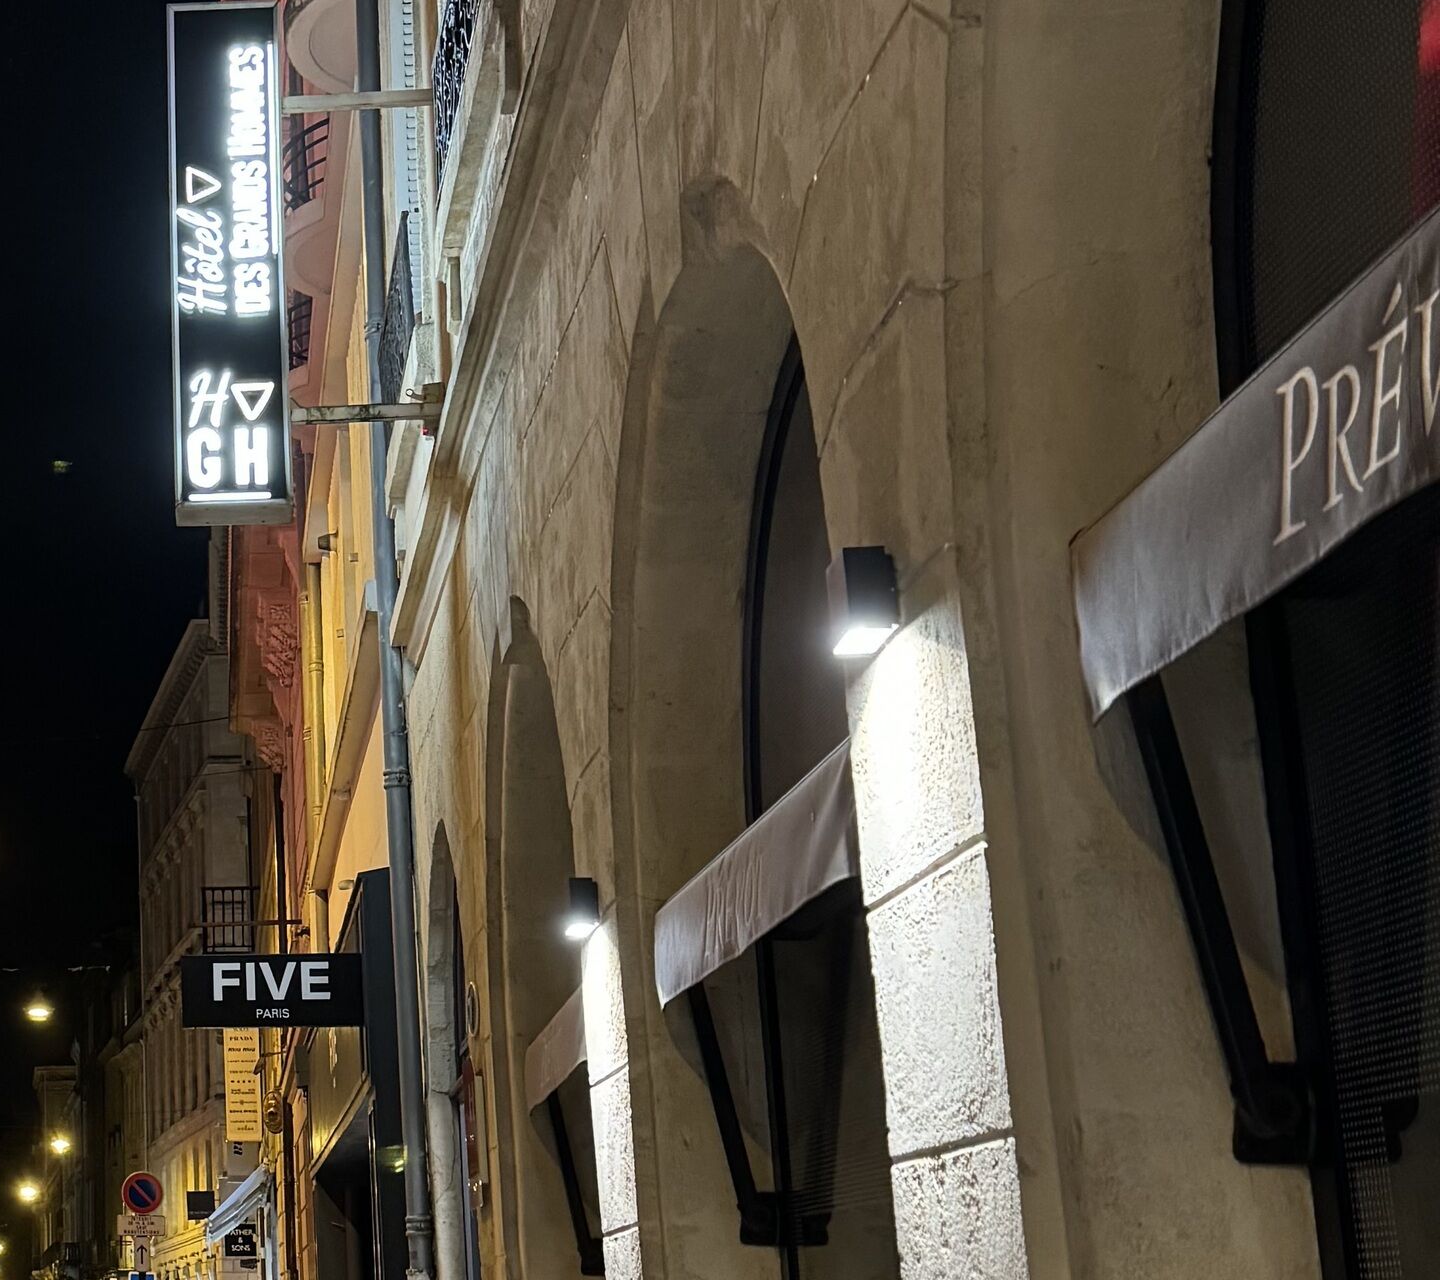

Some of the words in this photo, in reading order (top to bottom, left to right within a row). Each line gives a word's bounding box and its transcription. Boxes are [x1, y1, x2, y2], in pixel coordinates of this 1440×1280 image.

[228, 159, 271, 260] GRANDS
[177, 206, 228, 317] Hôtel
[233, 261, 272, 318] DES
[212, 961, 331, 1002] FIVE
[255, 1007, 290, 1019] PARIS
[231, 1244, 251, 1252] SONS
